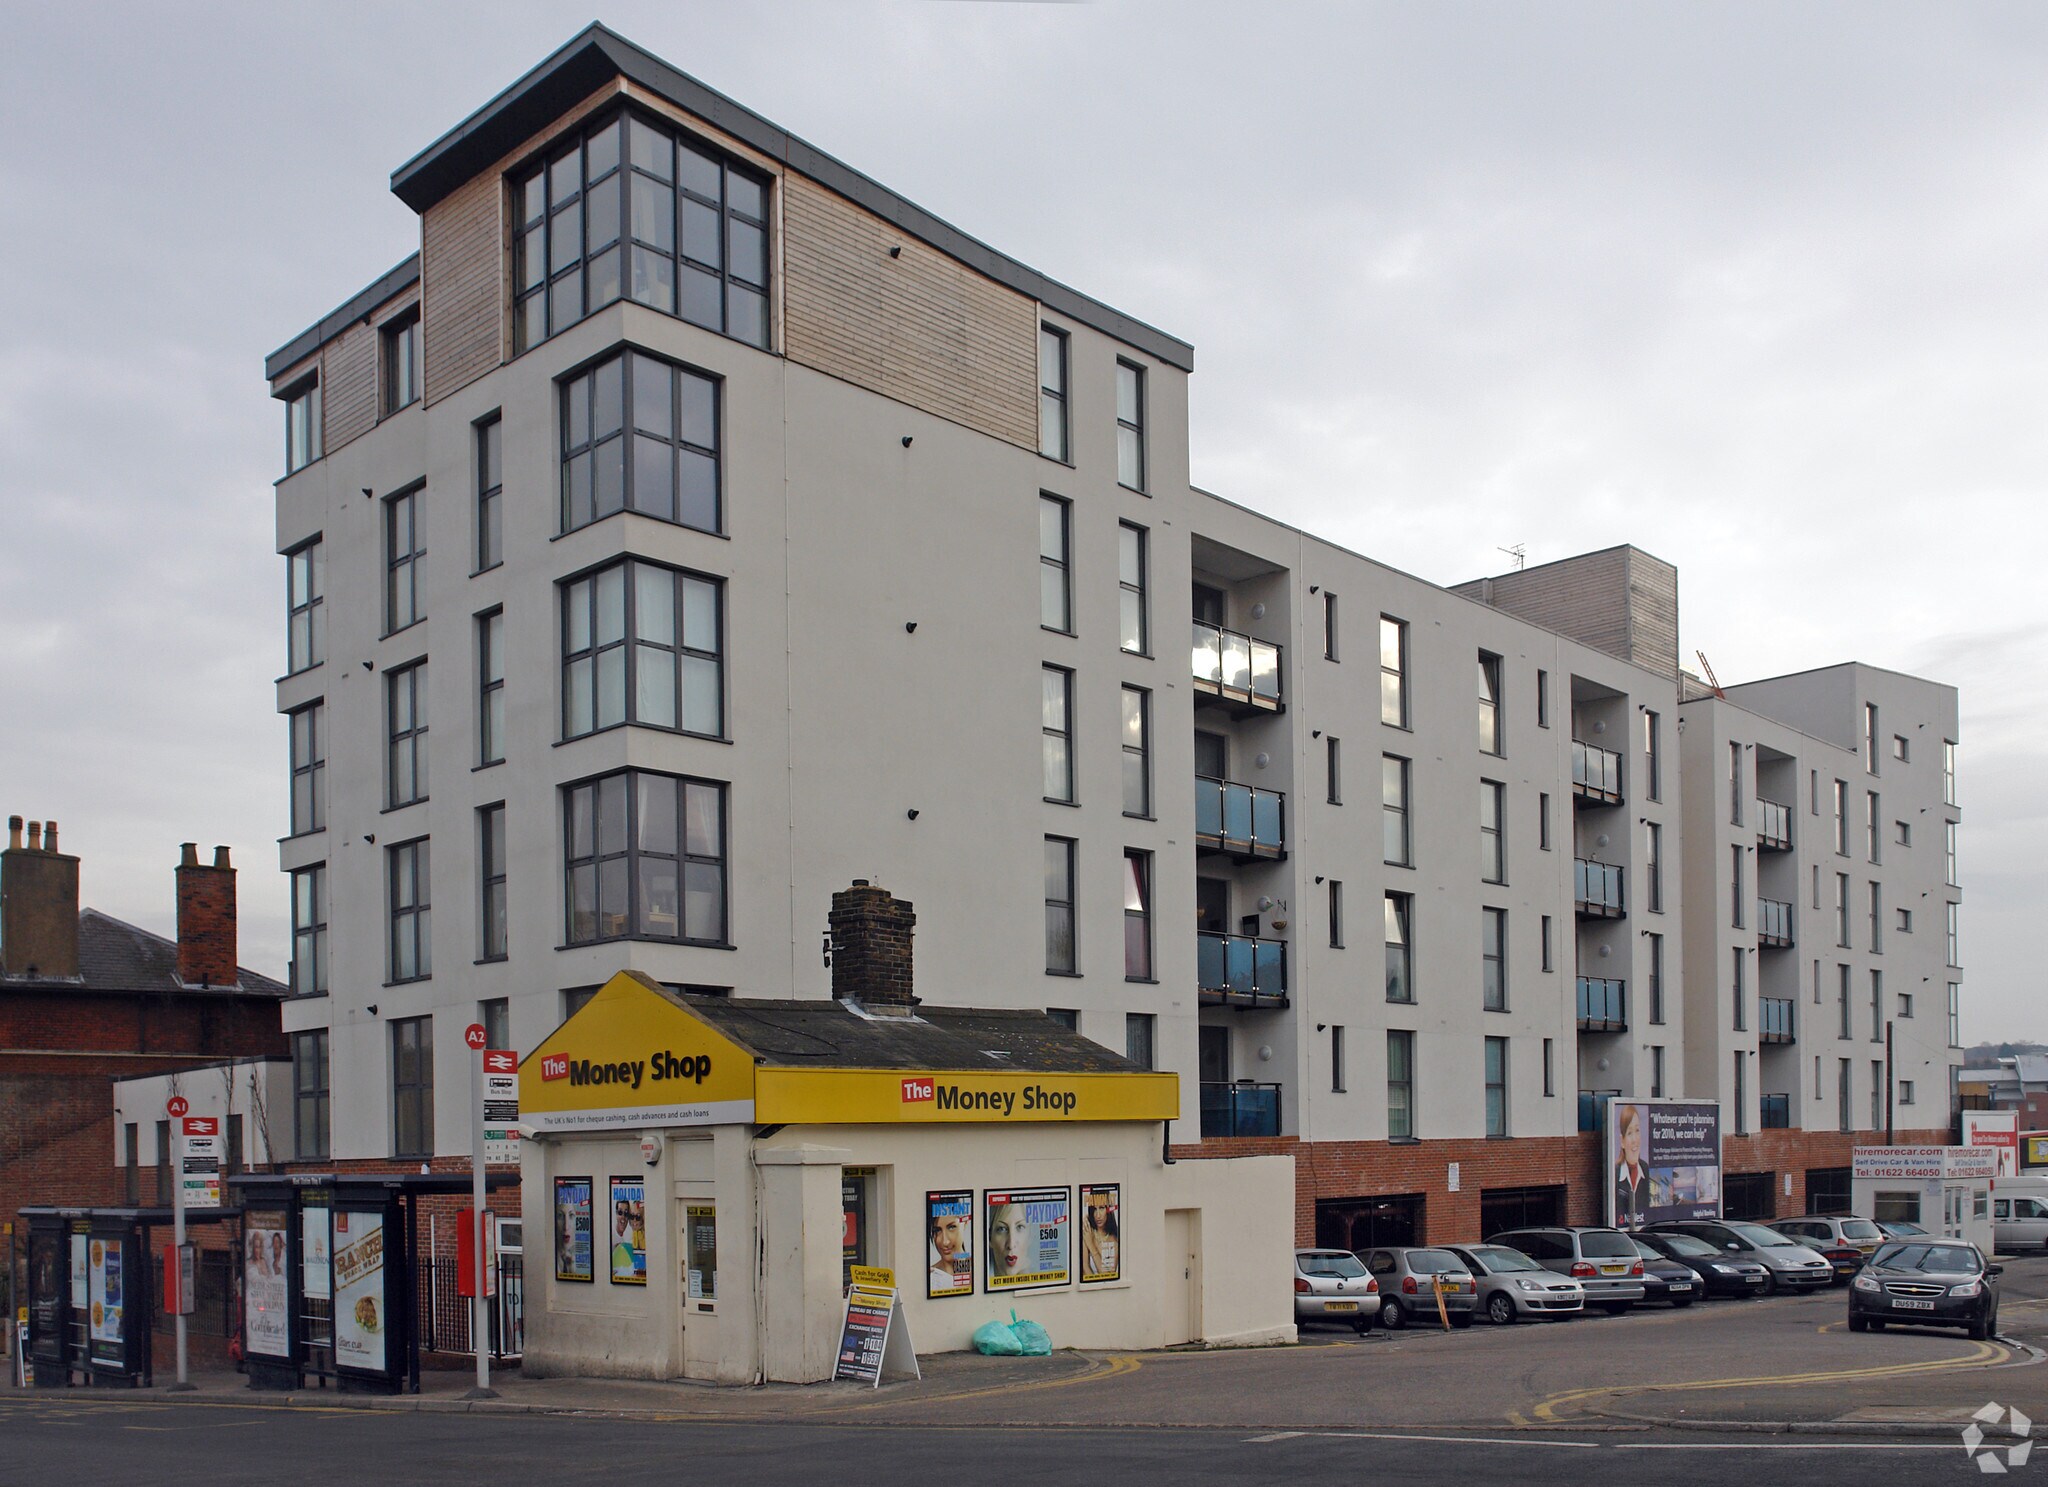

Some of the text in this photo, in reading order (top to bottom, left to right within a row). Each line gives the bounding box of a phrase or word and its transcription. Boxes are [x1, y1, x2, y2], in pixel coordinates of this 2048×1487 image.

[468, 1031, 485, 1043] A2
[543, 1050, 711, 1089] The Money Shop
[904, 1082, 1076, 1116] The Money Shop
[544, 1117, 553, 1125] The
[555, 1116, 565, 1124] UK's
[586, 1115, 604, 1124] cheque
[628, 1113, 640, 1121] cash
[641, 1112, 667, 1120] advances
[667, 1111, 678, 1119] and
[680, 1110, 692, 1118] cash
[693, 1109, 709, 1117] loans
[1676, 1131, 1683, 1139] we
[1684, 1131, 1693, 1139] can
[1854, 1148, 1943, 1156] hiremorecar.com
[1948, 1147, 1993, 1158] hiremorecar.com
[1958, 1167, 1974, 1176] 01622
[559, 1187, 589, 1204] PAYDAY
[932, 1203, 970, 1217] INSTANT
[1026, 1203, 1065, 1223] PAYDAY
[1040, 1228, 1058, 1240] £500
[335, 1234, 382, 1275] RANCH
[953, 1259, 970, 1273] CASHED
[508, 1293, 520, 1305] TO
[1896, 1300, 1914, 1308] DU59
[849, 1324, 870, 1332] EXCHANGE
